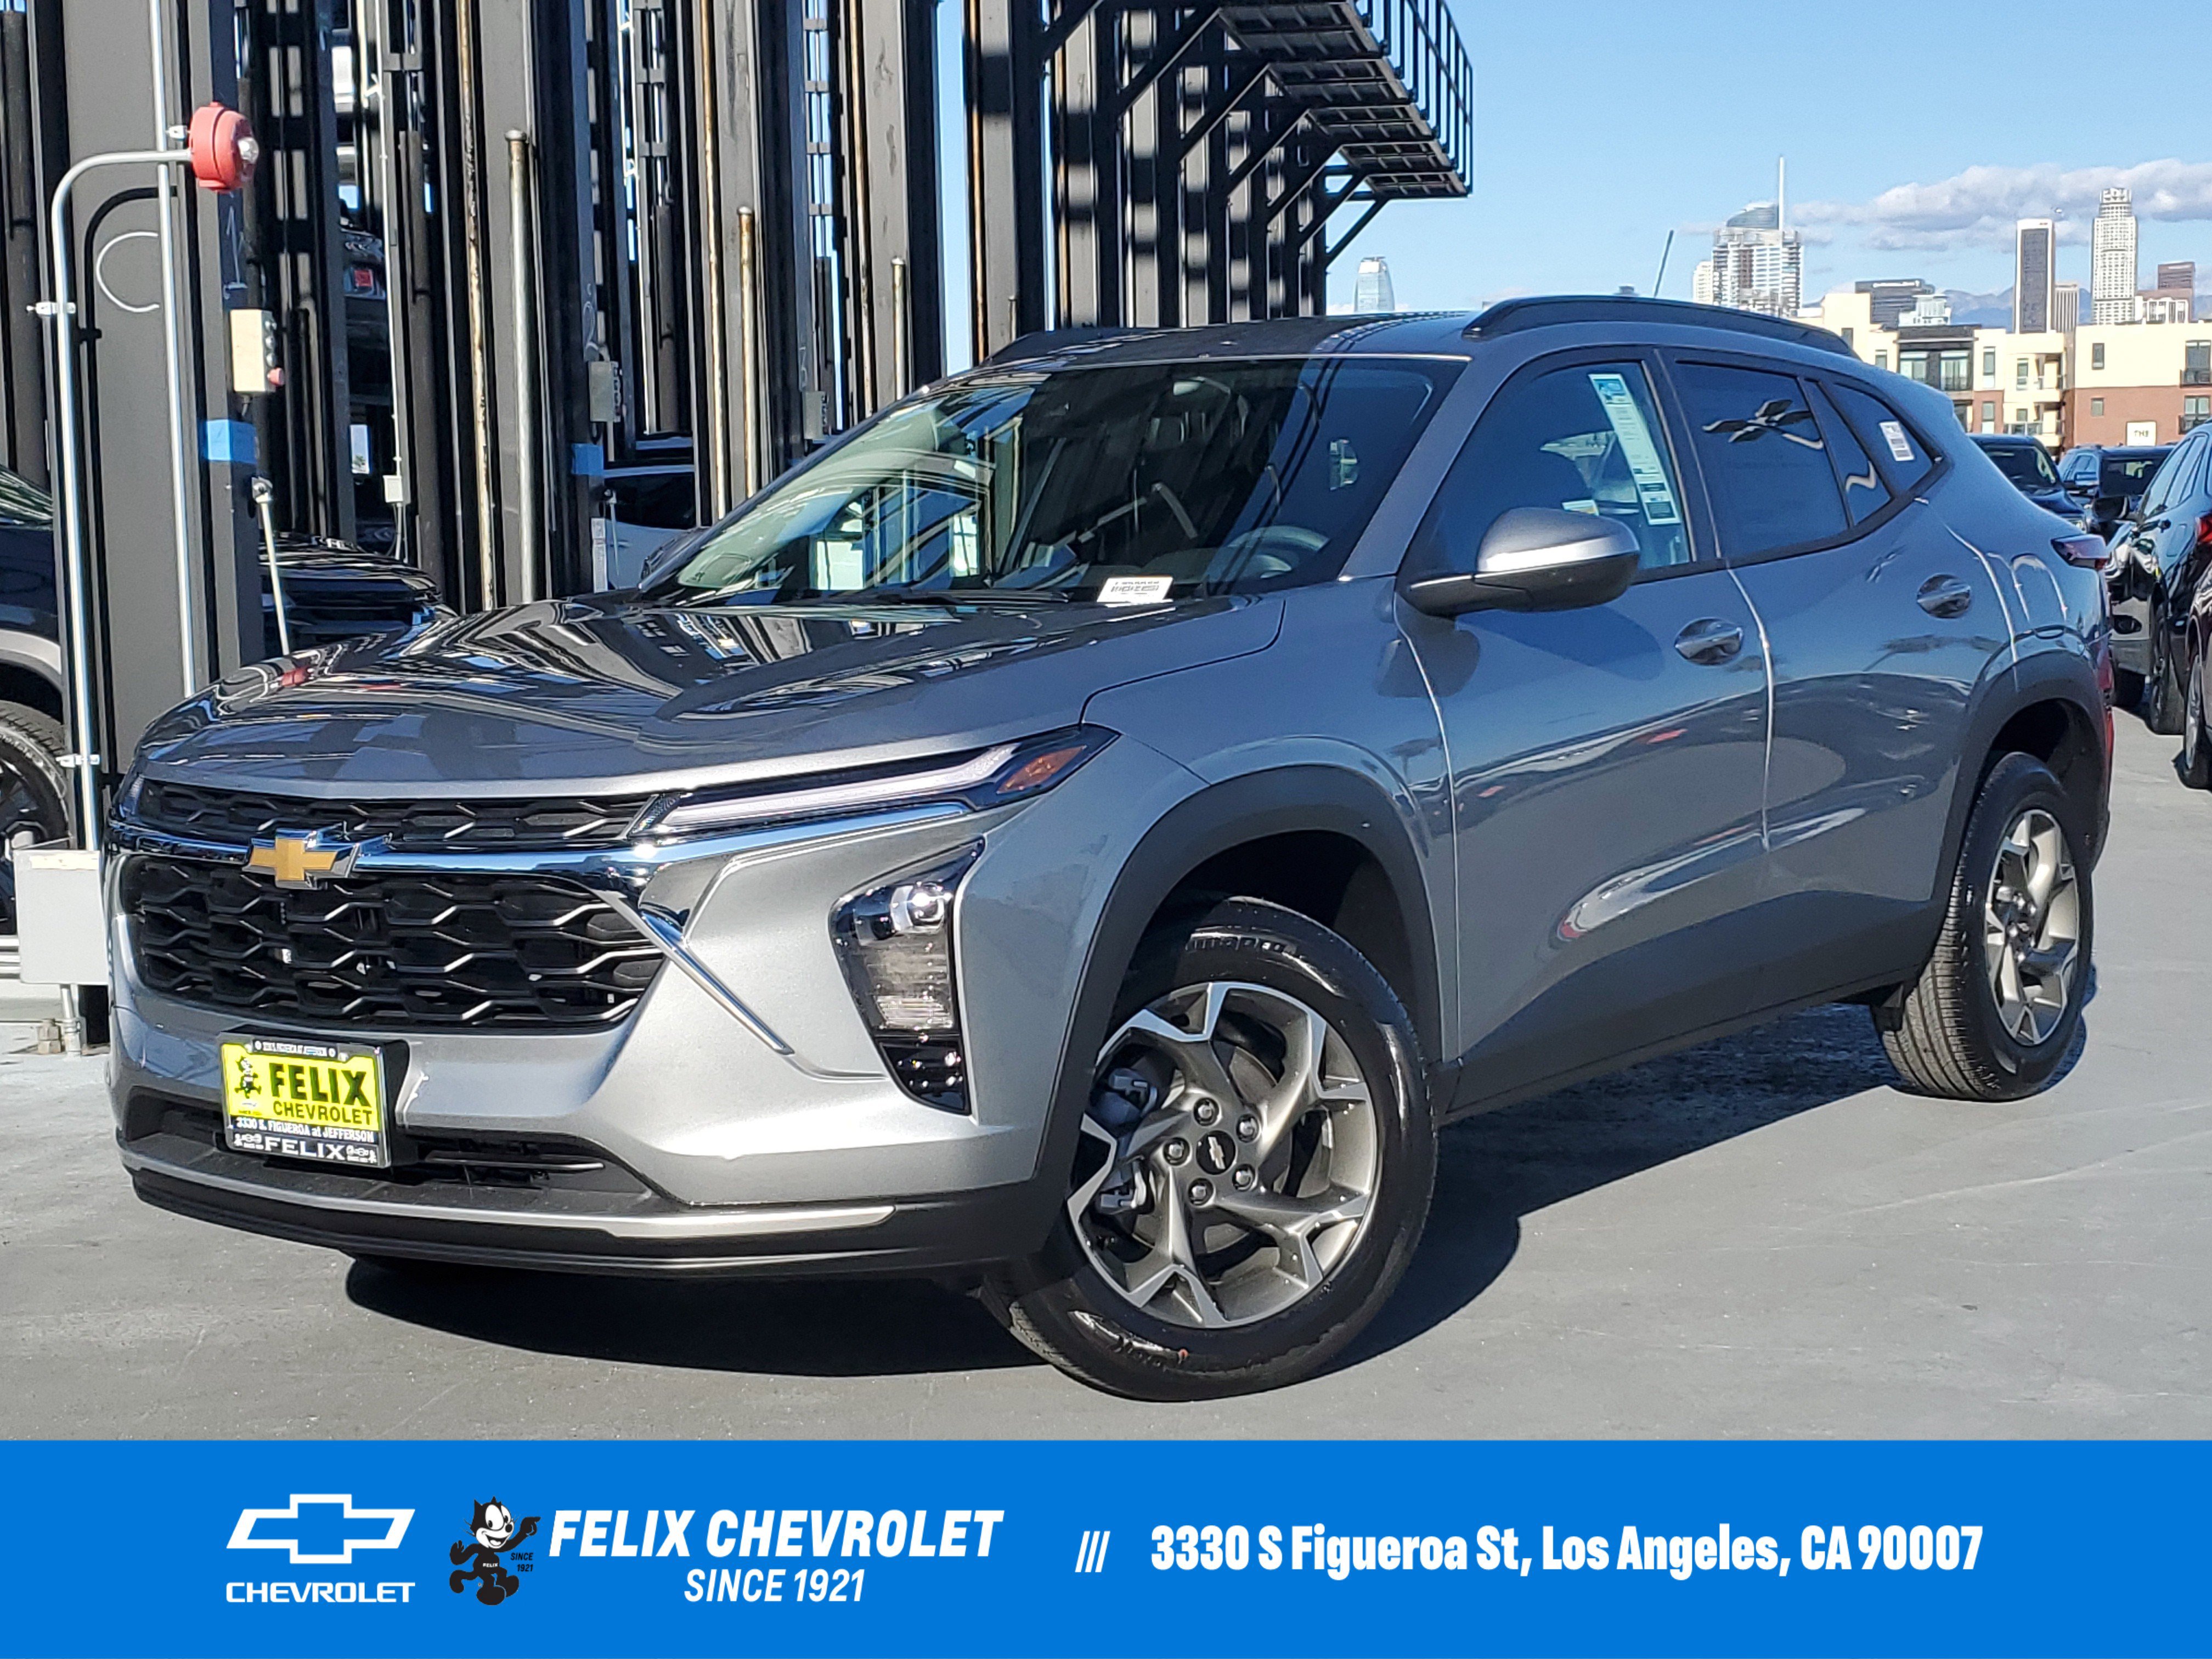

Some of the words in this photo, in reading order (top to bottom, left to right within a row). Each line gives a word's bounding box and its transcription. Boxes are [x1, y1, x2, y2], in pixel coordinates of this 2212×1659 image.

[269, 1062, 371, 1108] FELIX
[273, 1101, 373, 1125] CHEVROLET
[268, 1120, 311, 1136] FIGUEROA
[312, 1126, 321, 1137] at
[323, 1126, 375, 1143] JEFFERSON
[264, 1136, 346, 1161] FELIX
